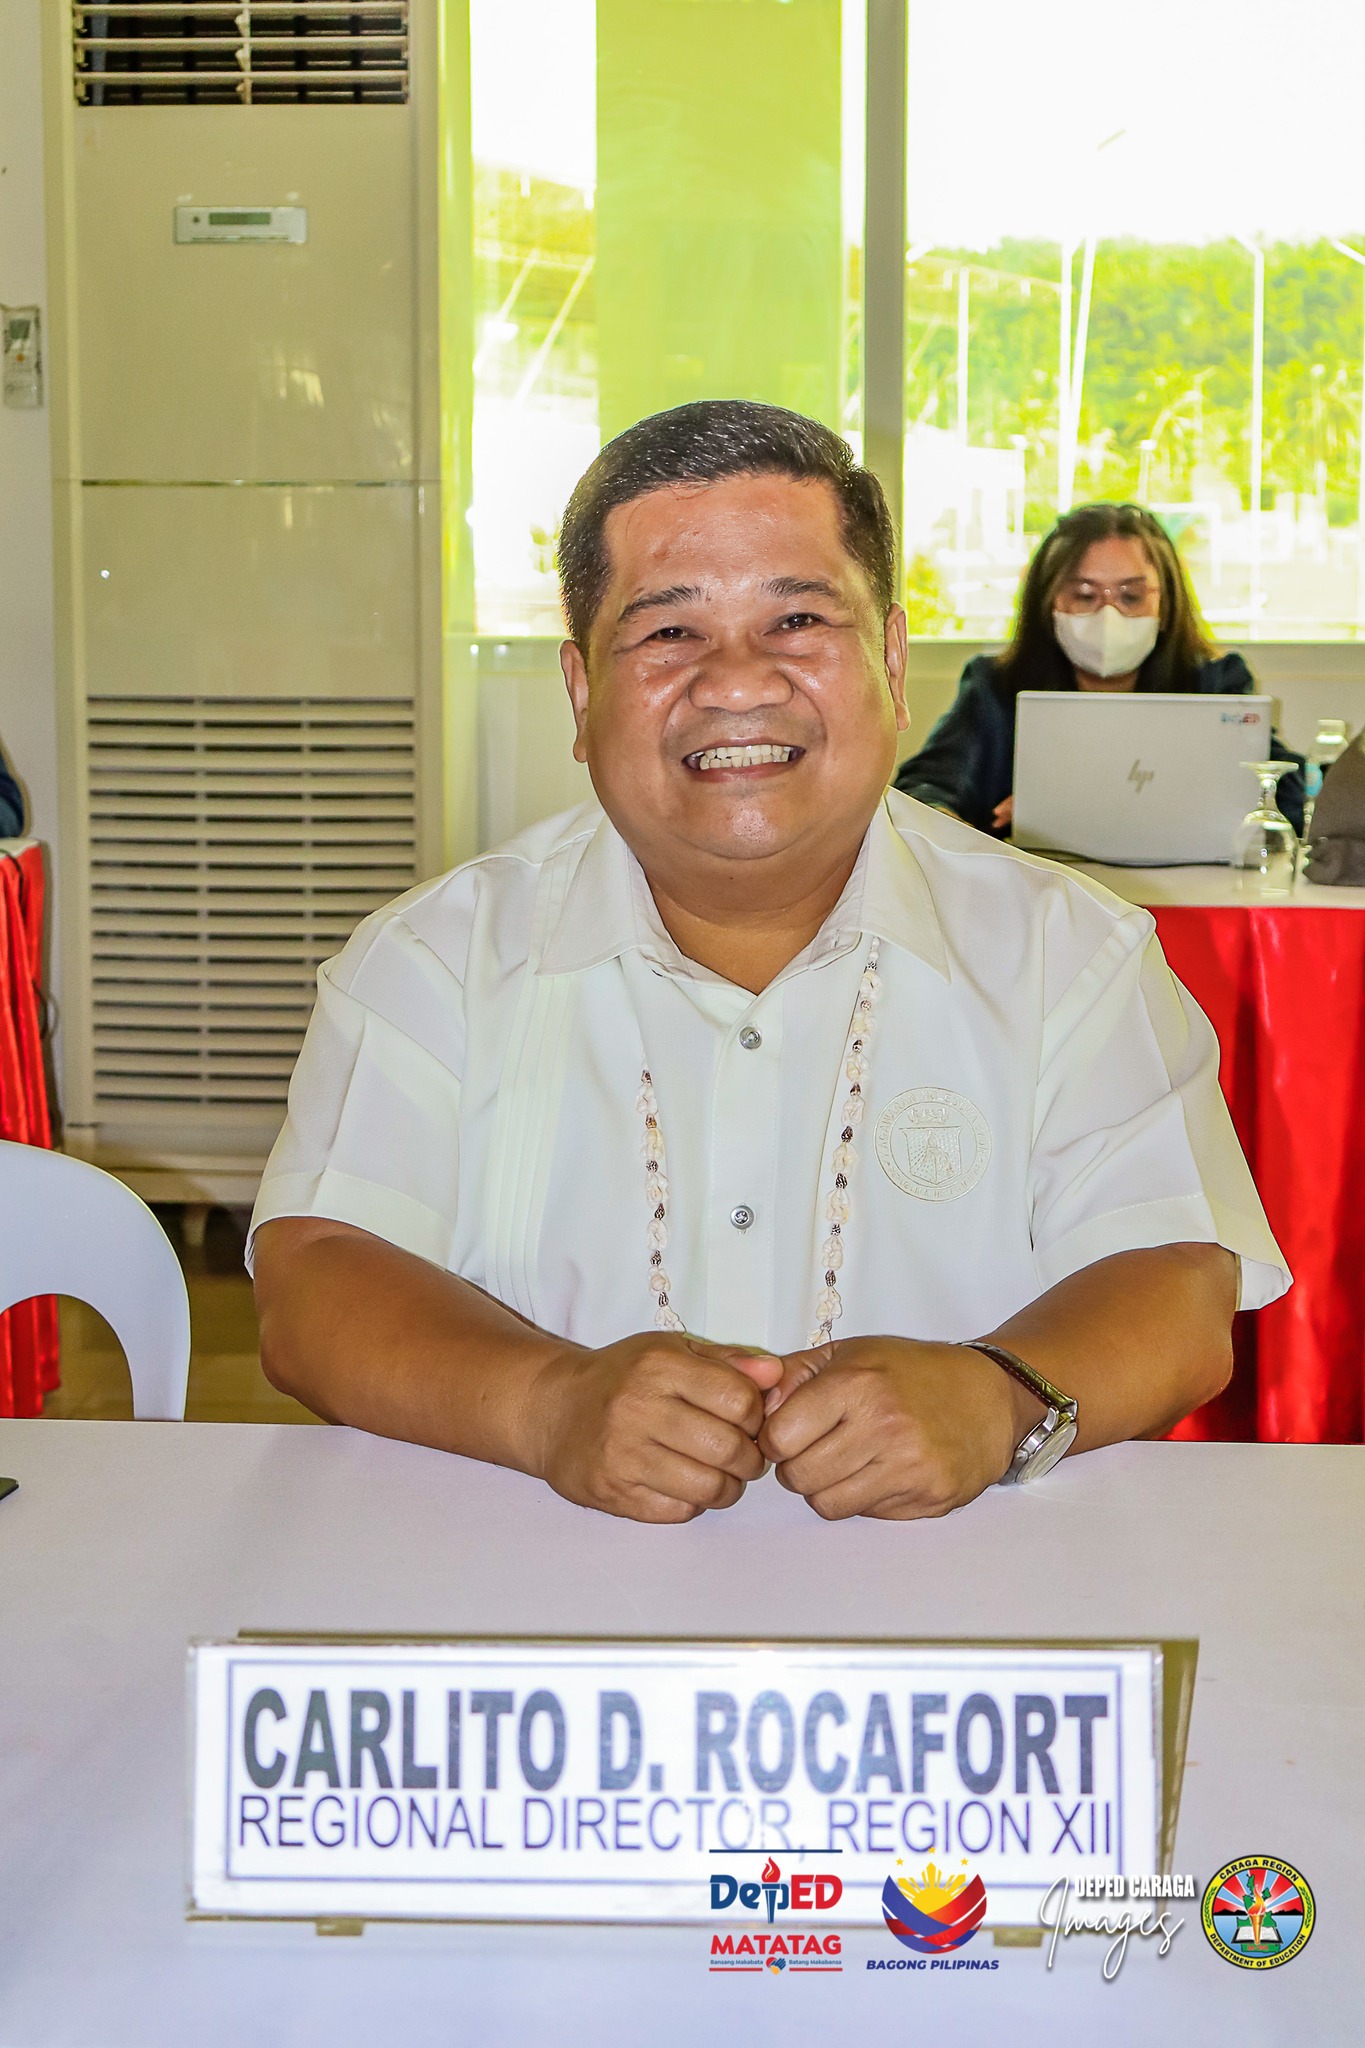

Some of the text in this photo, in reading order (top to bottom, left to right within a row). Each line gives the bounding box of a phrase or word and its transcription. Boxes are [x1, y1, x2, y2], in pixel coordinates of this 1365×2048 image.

[1127, 759, 1155, 793] hp
[243, 1688, 1109, 1796] CARLITO D. ROCAFORT
[239, 1795, 1110, 1863] REGIONAL DIRECTOR, REGION XII
